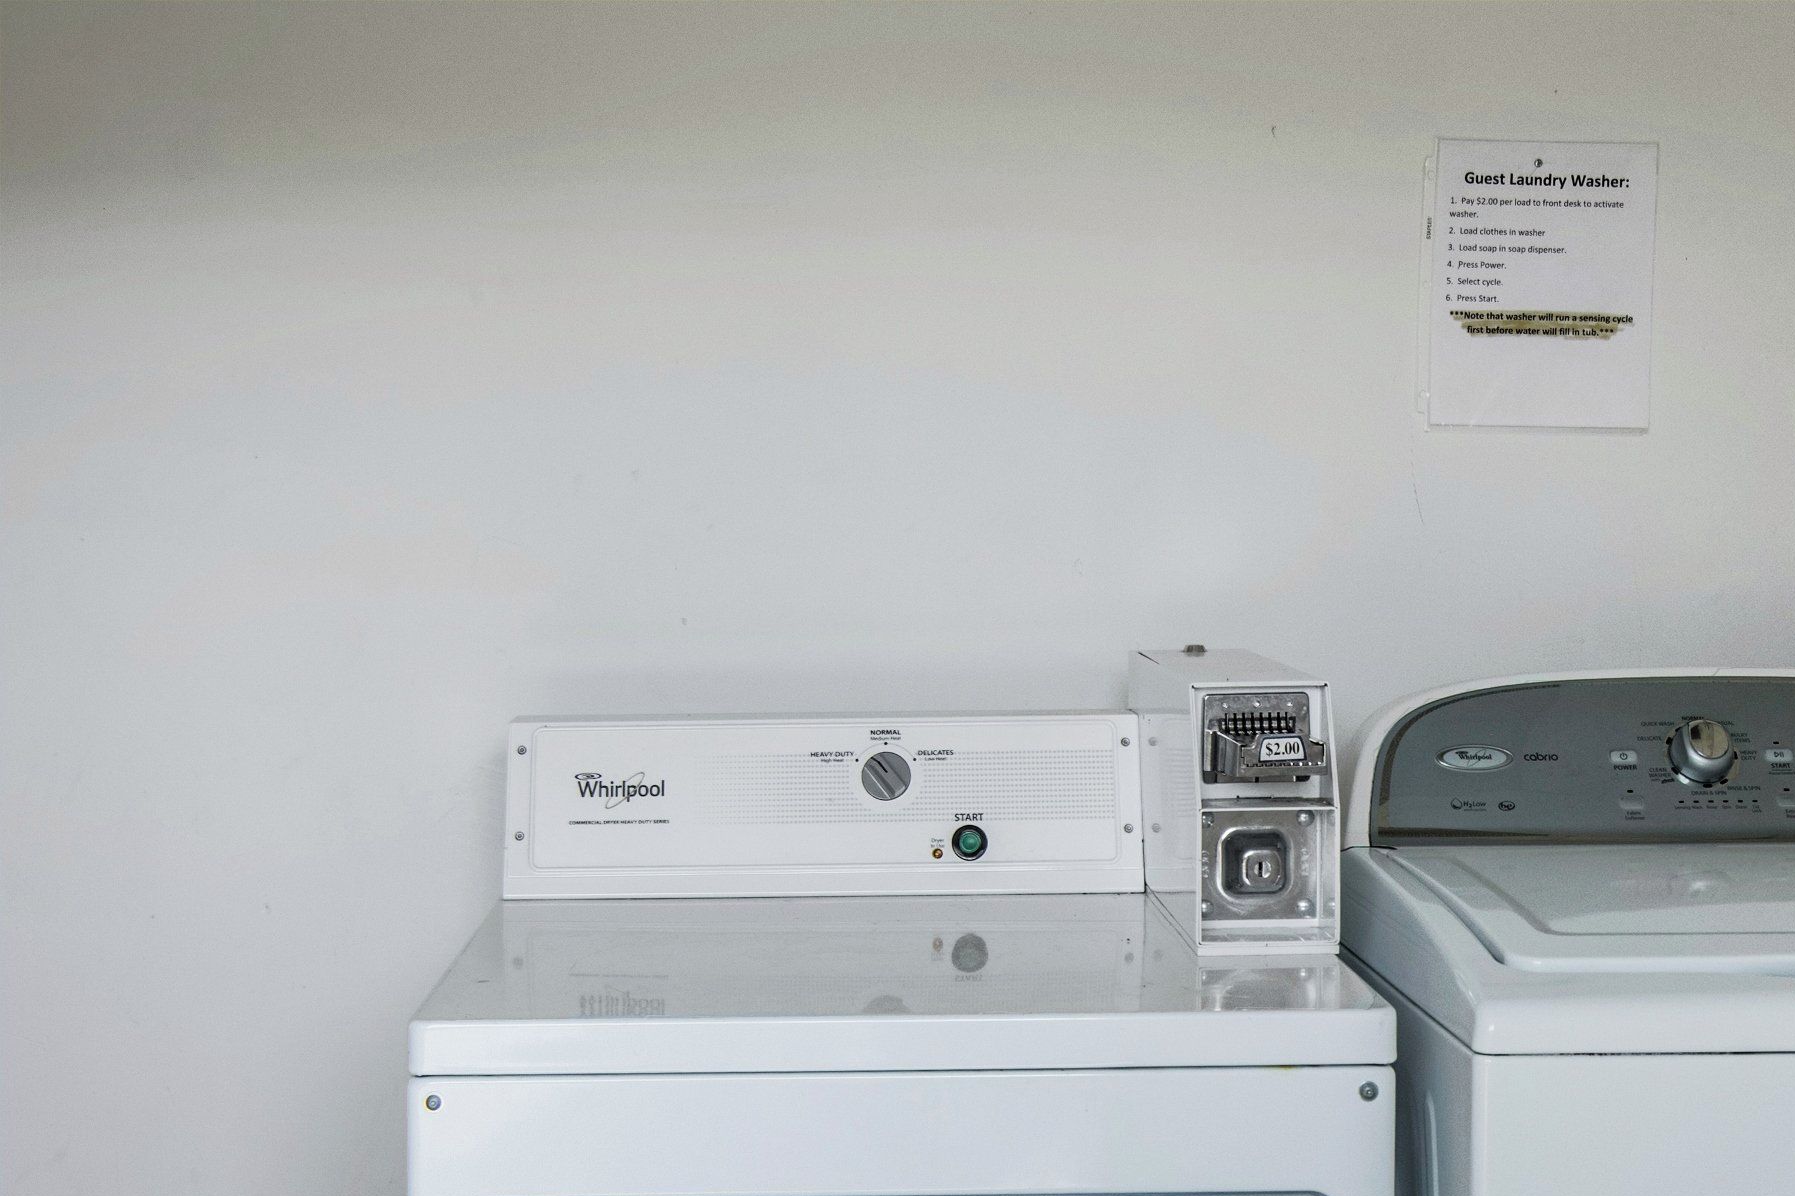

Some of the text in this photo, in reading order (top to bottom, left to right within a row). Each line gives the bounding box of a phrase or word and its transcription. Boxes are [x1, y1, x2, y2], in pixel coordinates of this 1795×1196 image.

[1465, 172, 1630, 189] Guest Laundry Washer:
[1451, 197, 1457, 205] 1.
[1461, 197, 1474, 206] Pay
[1476, 197, 1498, 206] $2.00
[1500, 199, 1512, 207] per
[1514, 198, 1531, 206] load
[1543, 199, 1561, 207] front
[1564, 199, 1581, 208] desk
[1584, 200, 1592, 208] to
[1594, 200, 1624, 209] activate
[1460, 227, 1477, 235] Load
[1480, 228, 1507, 236] clothes
[1518, 229, 1545, 237] washer
[1459, 244, 1477, 252] Load
[1479, 246, 1497, 254] soap
[1527, 246, 1567, 255] dispenser.
[1458, 261, 1478, 270] Press
[1480, 262, 1507, 270] Power.
[1458, 278, 1480, 286] Select
[1482, 279, 1503, 287] cycle.
[1457, 295, 1476, 303] Press
[1479, 295, 1499, 303] Start.
[1486, 312, 1503, 320] that
[1506, 313, 1536, 321] washer
[1539, 313, 1553, 322] will
[1579, 315, 1610, 324] sensing
[1612, 315, 1633, 324] cycle
[1467, 326, 1483, 334] first
[1486, 326, 1513, 335] before
[1516, 328, 1540, 336] water
[1542, 327, 1557, 336] will
[1559, 327, 1570, 336] fill
[1572, 328, 1579, 336] in
[1265, 741, 1300, 756] $2.00
[1458, 752, 1492, 761] Whirlpool
[1524, 752, 1558, 761] cabrio
[578, 780, 665, 802] Whirlpool
[954, 813, 984, 822] START
